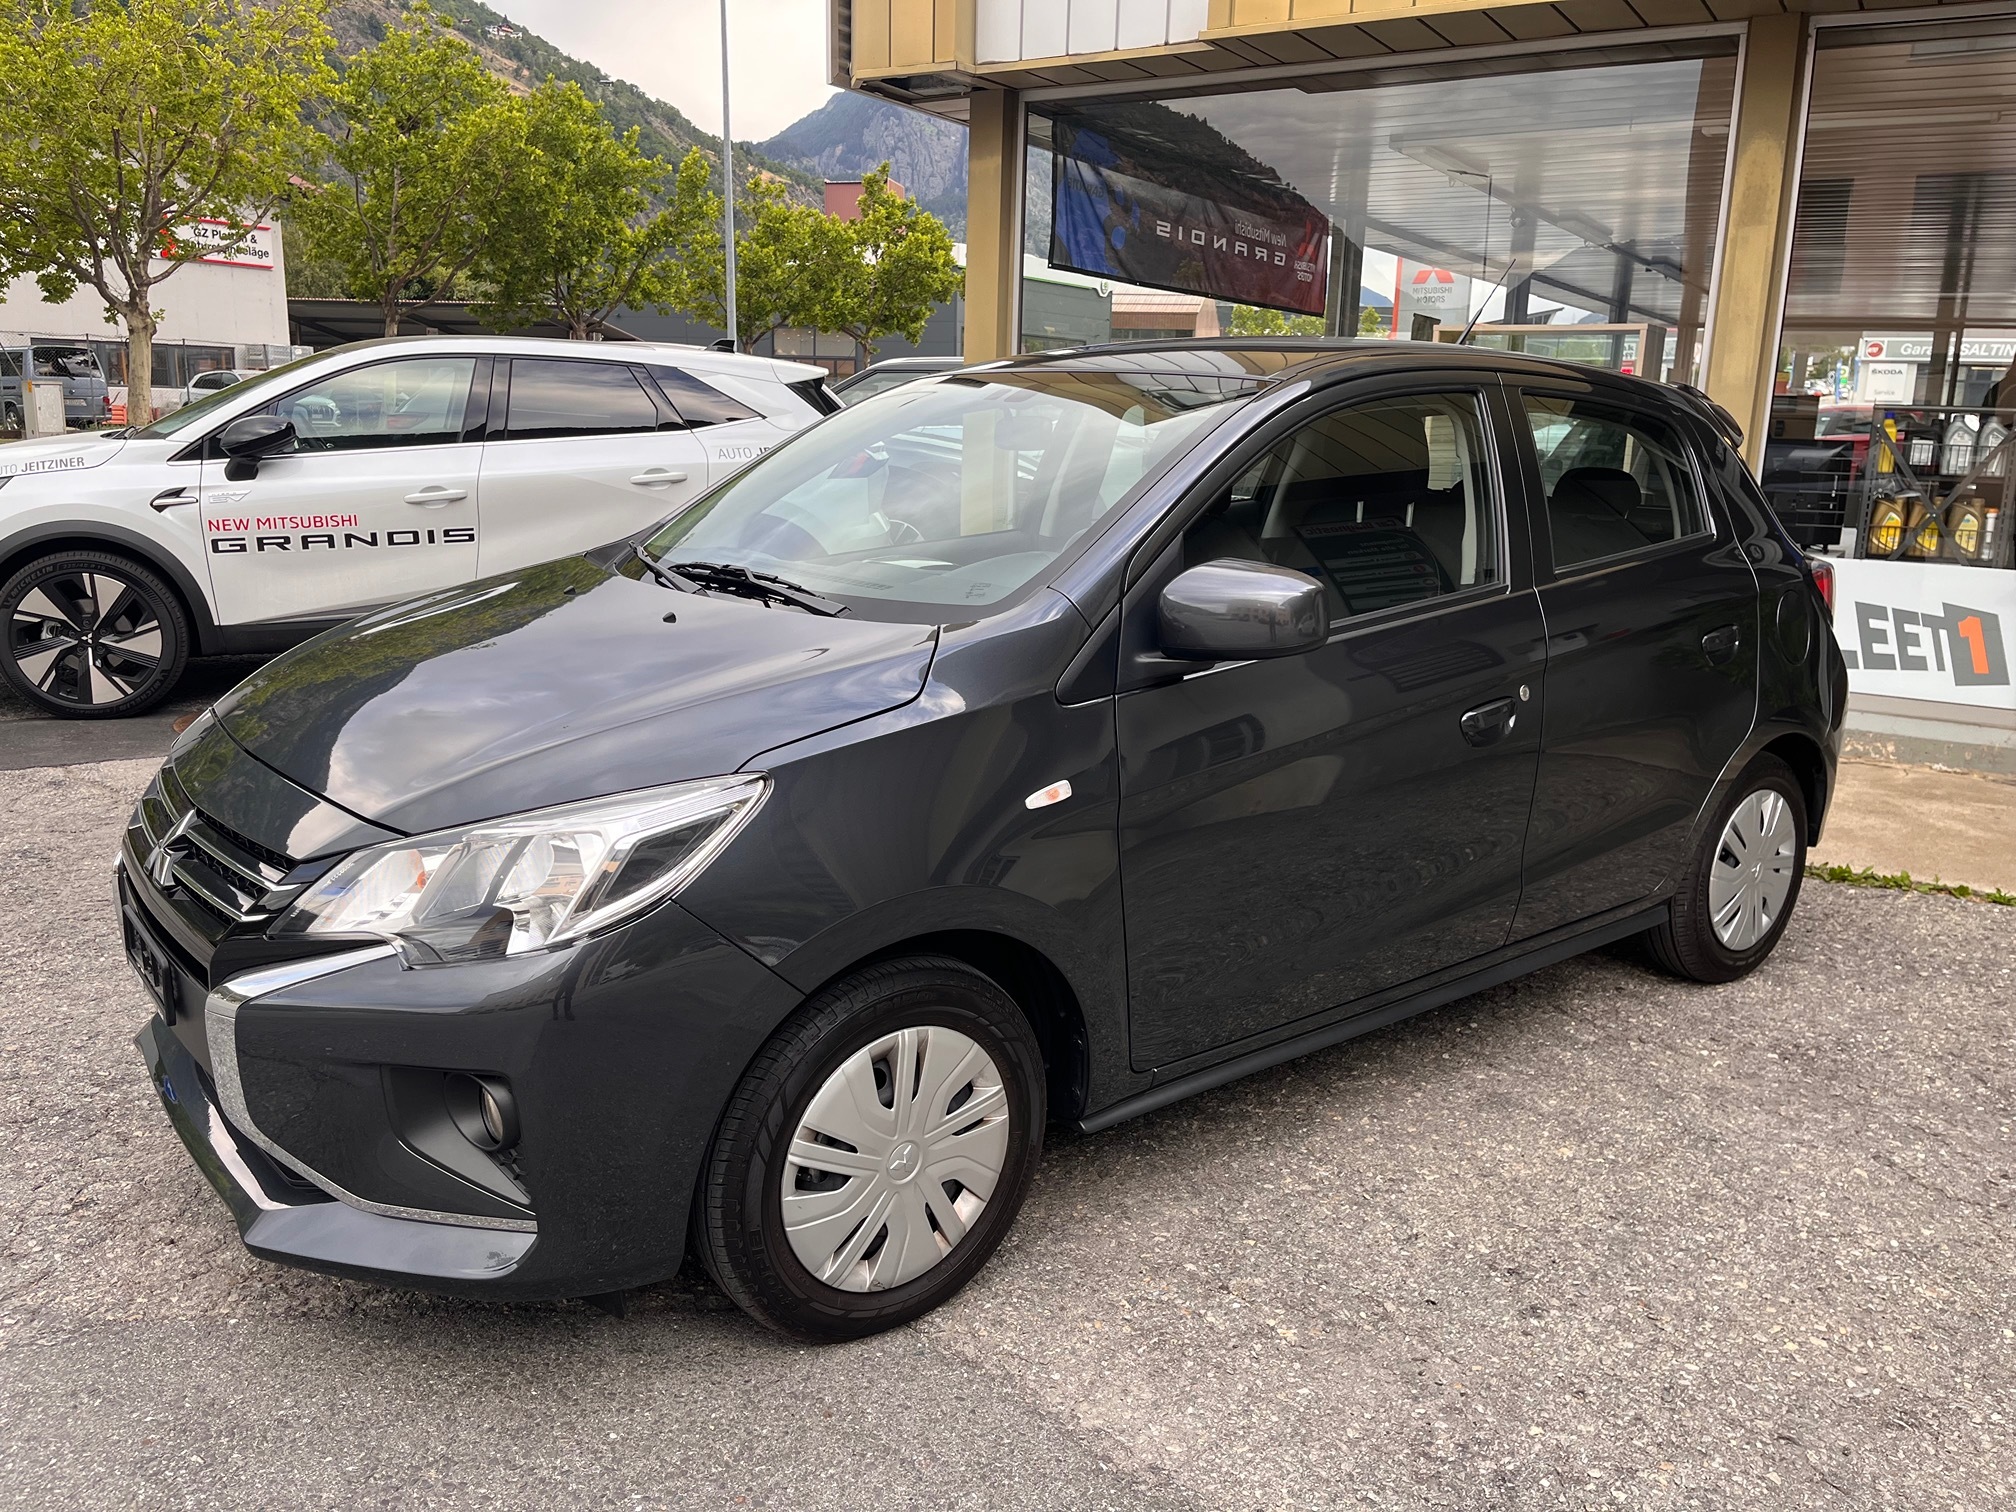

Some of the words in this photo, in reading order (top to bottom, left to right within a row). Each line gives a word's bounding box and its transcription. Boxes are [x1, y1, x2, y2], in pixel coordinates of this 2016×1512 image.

[193, 227, 209, 238] GZ
[250, 234, 258, 244] &
[1412, 286, 1453, 295] MITSUBISHI
[1416, 295, 1446, 304] MOTORS
[1900, 342, 1955, 356] Garae
[718, 447, 753, 460] AUTO
[21, 456, 85, 473] JEITZINER
[207, 518, 250, 532] NEW
[256, 514, 358, 530] MITSUBISHI
[210, 527, 475, 554] GRANDIS
[11, 565, 54, 598] MICHELIN
